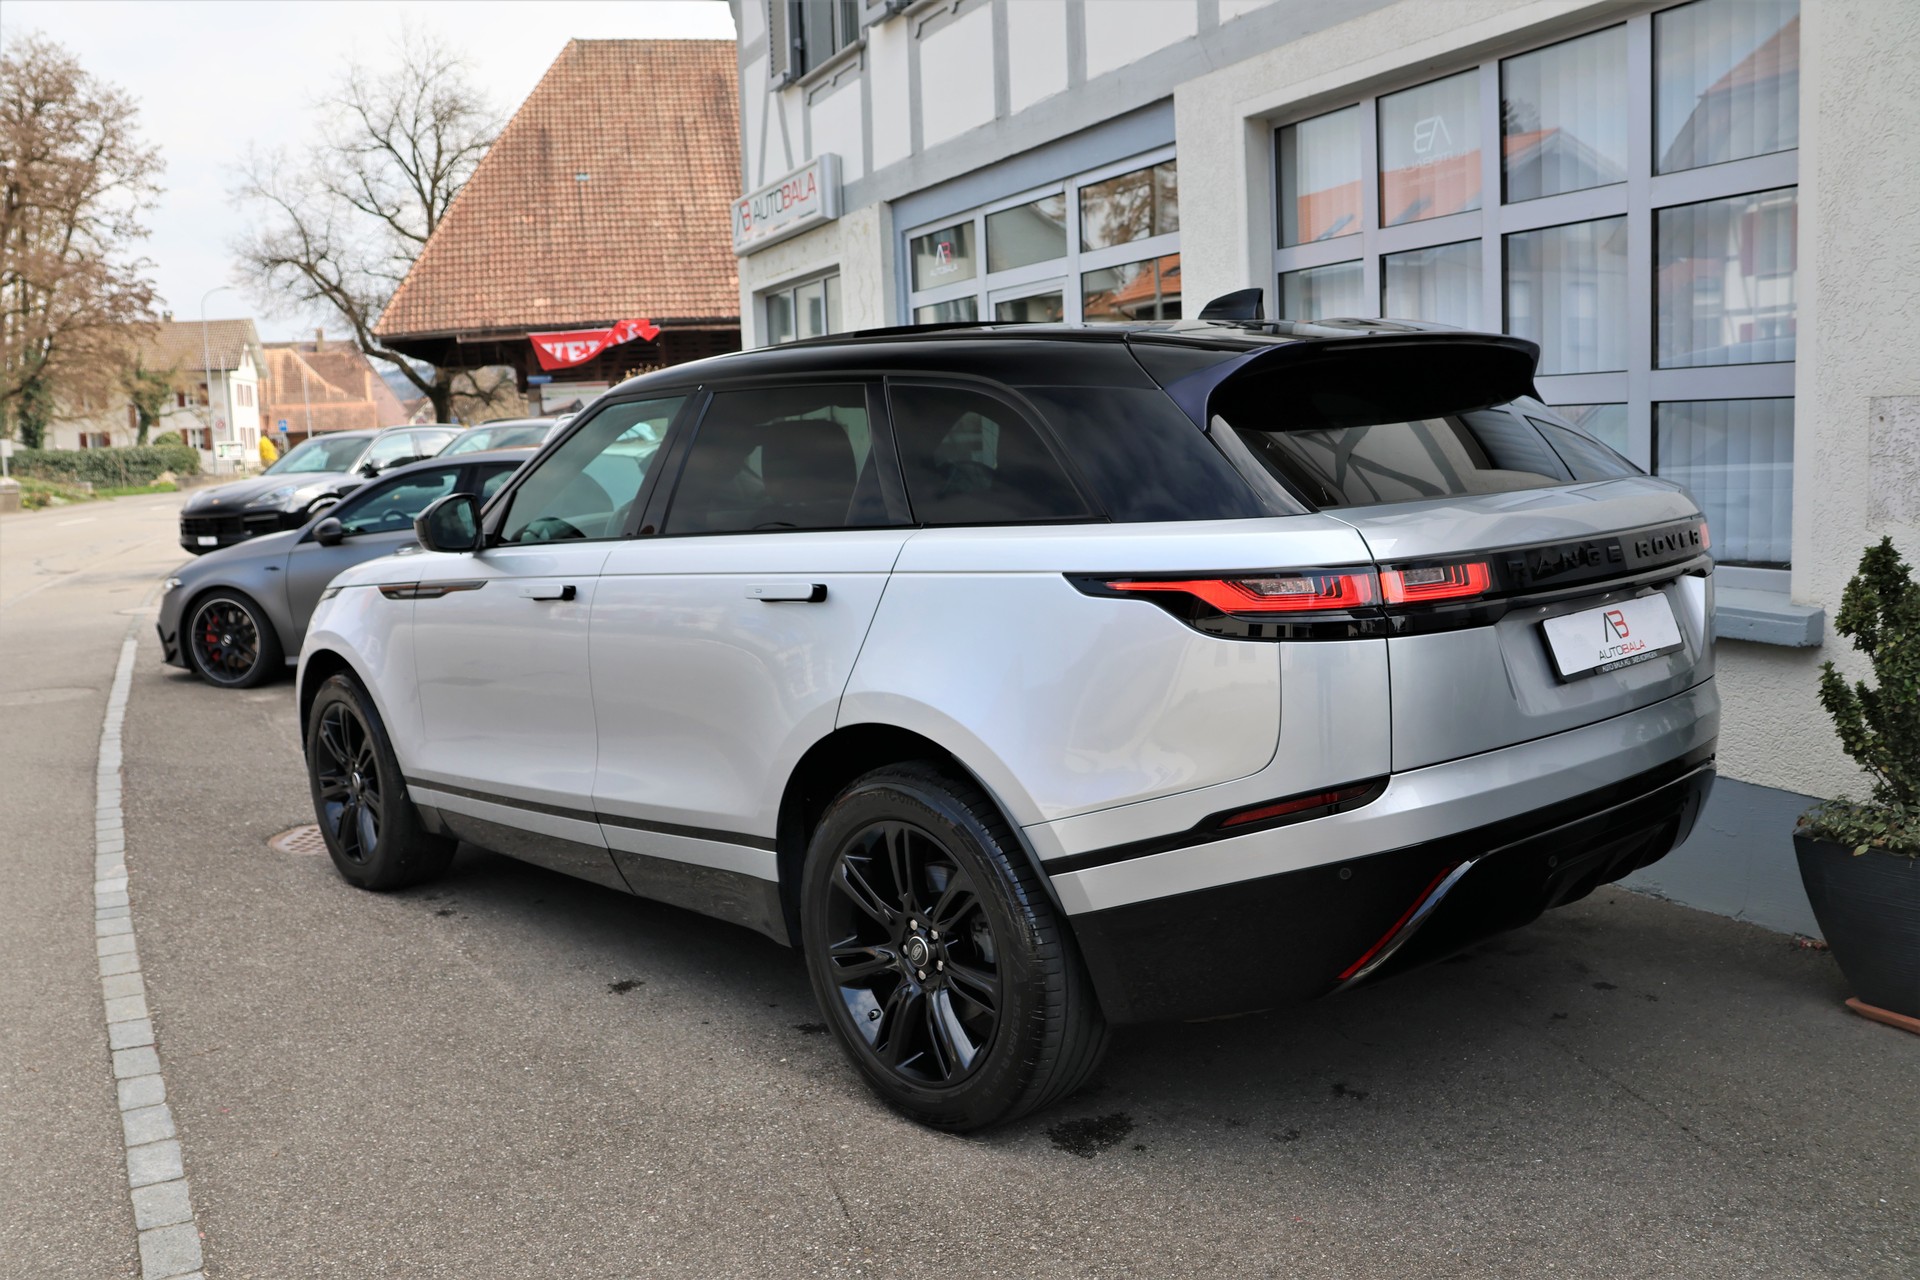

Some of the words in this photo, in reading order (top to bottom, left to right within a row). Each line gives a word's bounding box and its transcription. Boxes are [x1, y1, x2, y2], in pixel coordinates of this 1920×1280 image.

[753, 171, 817, 225] AUTOBALA
[1506, 544, 1623, 579] RANGE
[1634, 529, 1700, 559] ROVER
[1599, 639, 1647, 661] AUTOBALA
